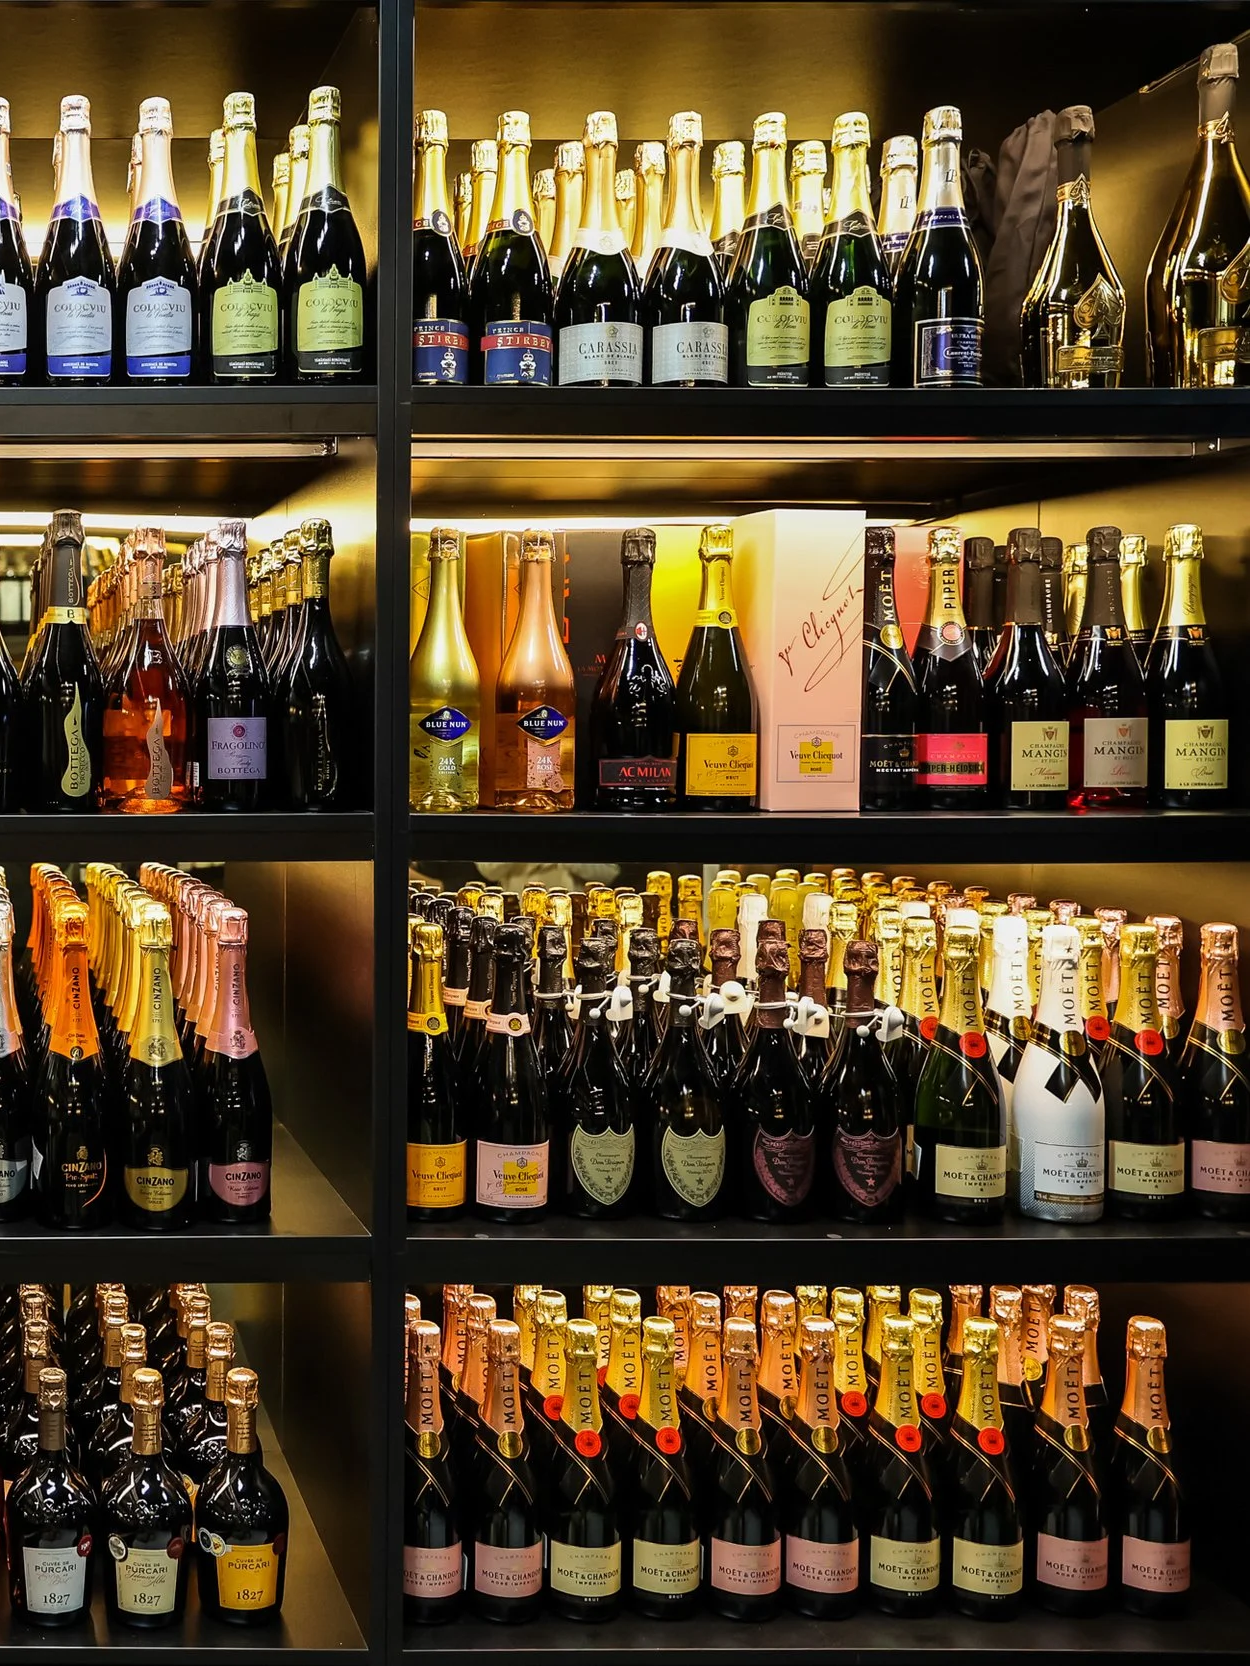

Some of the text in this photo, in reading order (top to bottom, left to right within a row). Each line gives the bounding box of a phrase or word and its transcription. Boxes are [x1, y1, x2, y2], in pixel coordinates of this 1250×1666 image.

[492, 326, 524, 334] PRINCE
[579, 341, 637, 355] CARASSIA
[943, 569, 956, 609] PIPER
[879, 571, 894, 621] MOËT
[426, 720, 447, 728] BLUE
[547, 719, 564, 727] NUN
[794, 730, 840, 739] CHAMPAGNE
[212, 740, 266, 750] FRAGOLINO
[70, 728, 79, 790] BOTTEGA
[790, 750, 842, 762] Veuve Clicquot
[152, 738, 160, 794] BOTTEGA
[217, 766, 260, 774] BOTTEGA
[620, 766, 670, 776] AC MILAN
[921, 964, 932, 1012] MOËT
[962, 976, 978, 1027] MOËT
[62, 1162, 102, 1172] CINZANO
[226, 1172, 261, 1181] CINZANO
[412, 1169, 434, 1179] Veuve
[493, 1170, 516, 1180] Veuve
[137, 1177, 174, 1186] CINZANO
[740, 1371, 752, 1422] MOËT
[981, 1369, 996, 1420] MOËT
[1067, 1369, 1080, 1418] MOËT
[1149, 1369, 1162, 1420] MOËT
[35, 1566, 76, 1574] PURCARI
[126, 1566, 168, 1574] PURCARI
[228, 1562, 270, 1570] PURCARI
[557, 1568, 579, 1579] MOËT
[719, 1566, 742, 1577] MOËT
[44, 1593, 70, 1604] 1827
[134, 1594, 160, 1604] 1827
[236, 1590, 264, 1600] 1827
